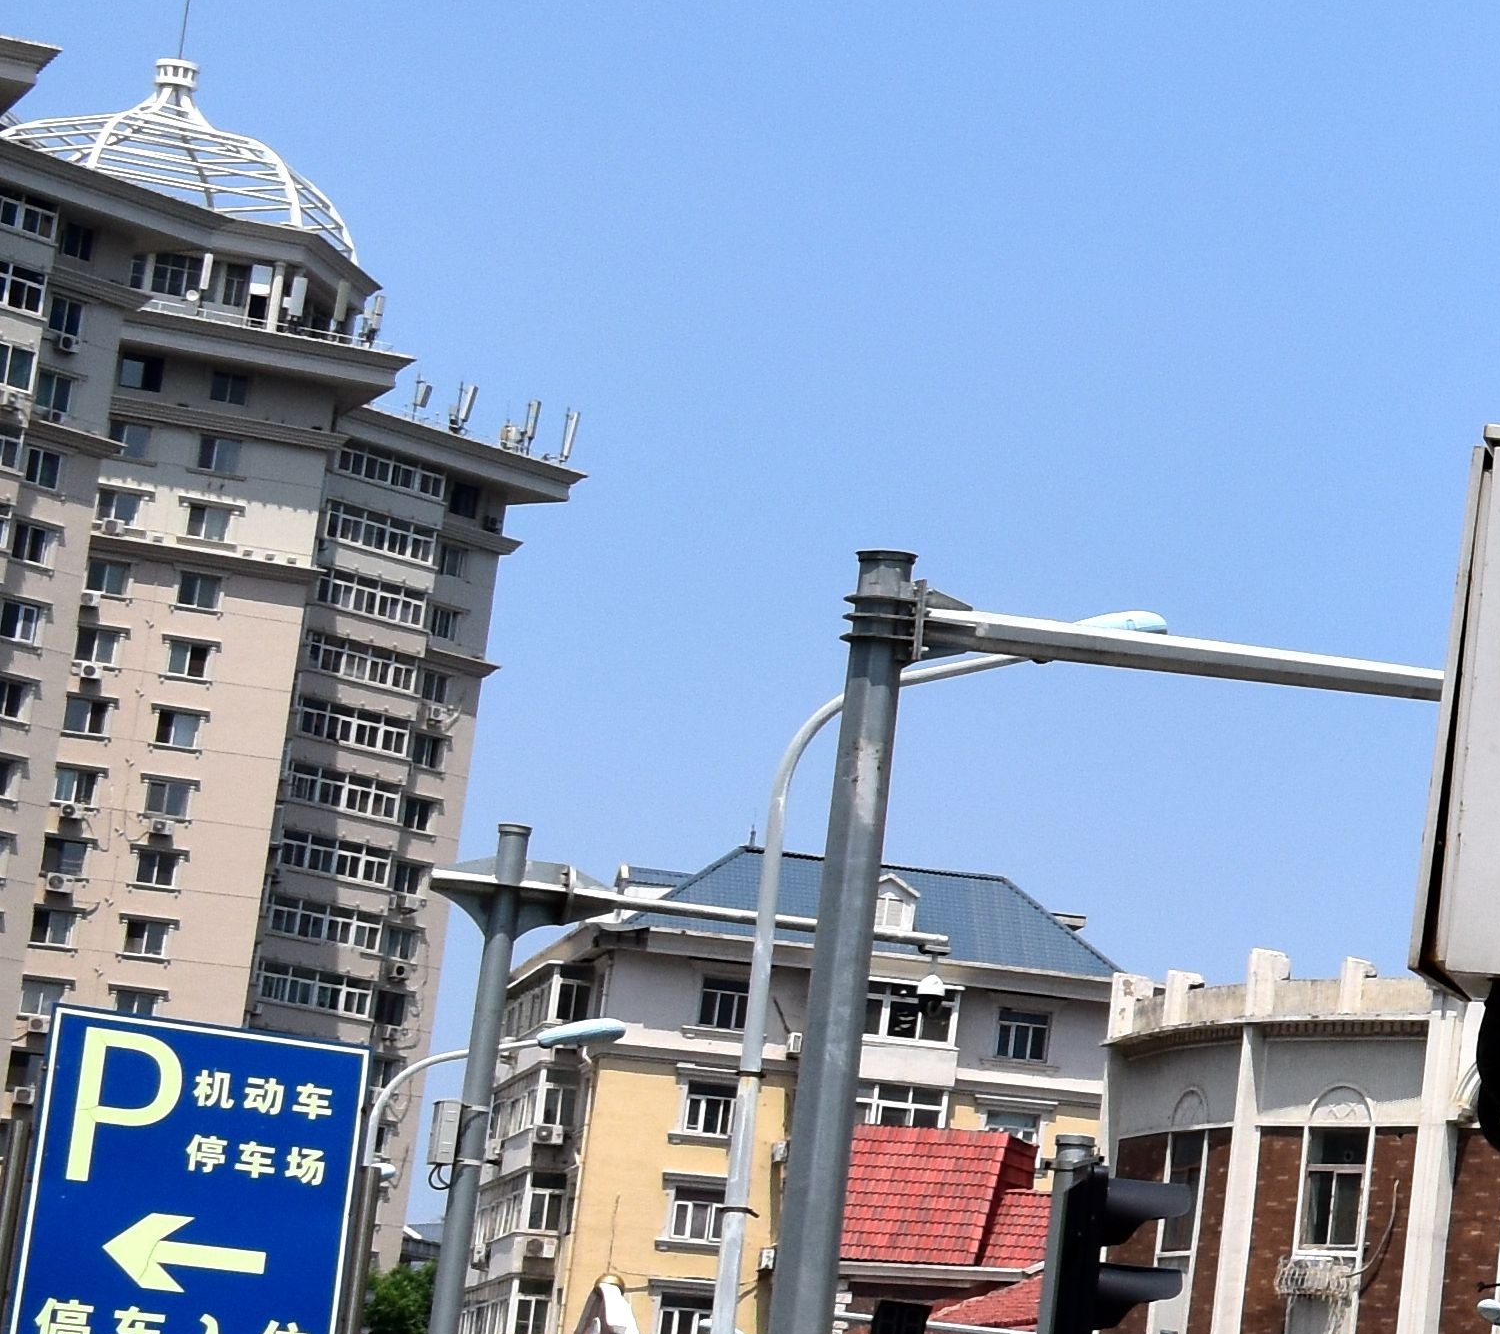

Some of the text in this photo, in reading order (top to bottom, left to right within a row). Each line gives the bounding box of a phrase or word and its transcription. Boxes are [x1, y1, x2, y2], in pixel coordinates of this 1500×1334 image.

[65, 1026, 182, 1182] P
[193, 1069, 333, 1121] 机动车
[186, 1134, 326, 1187] 停车场
